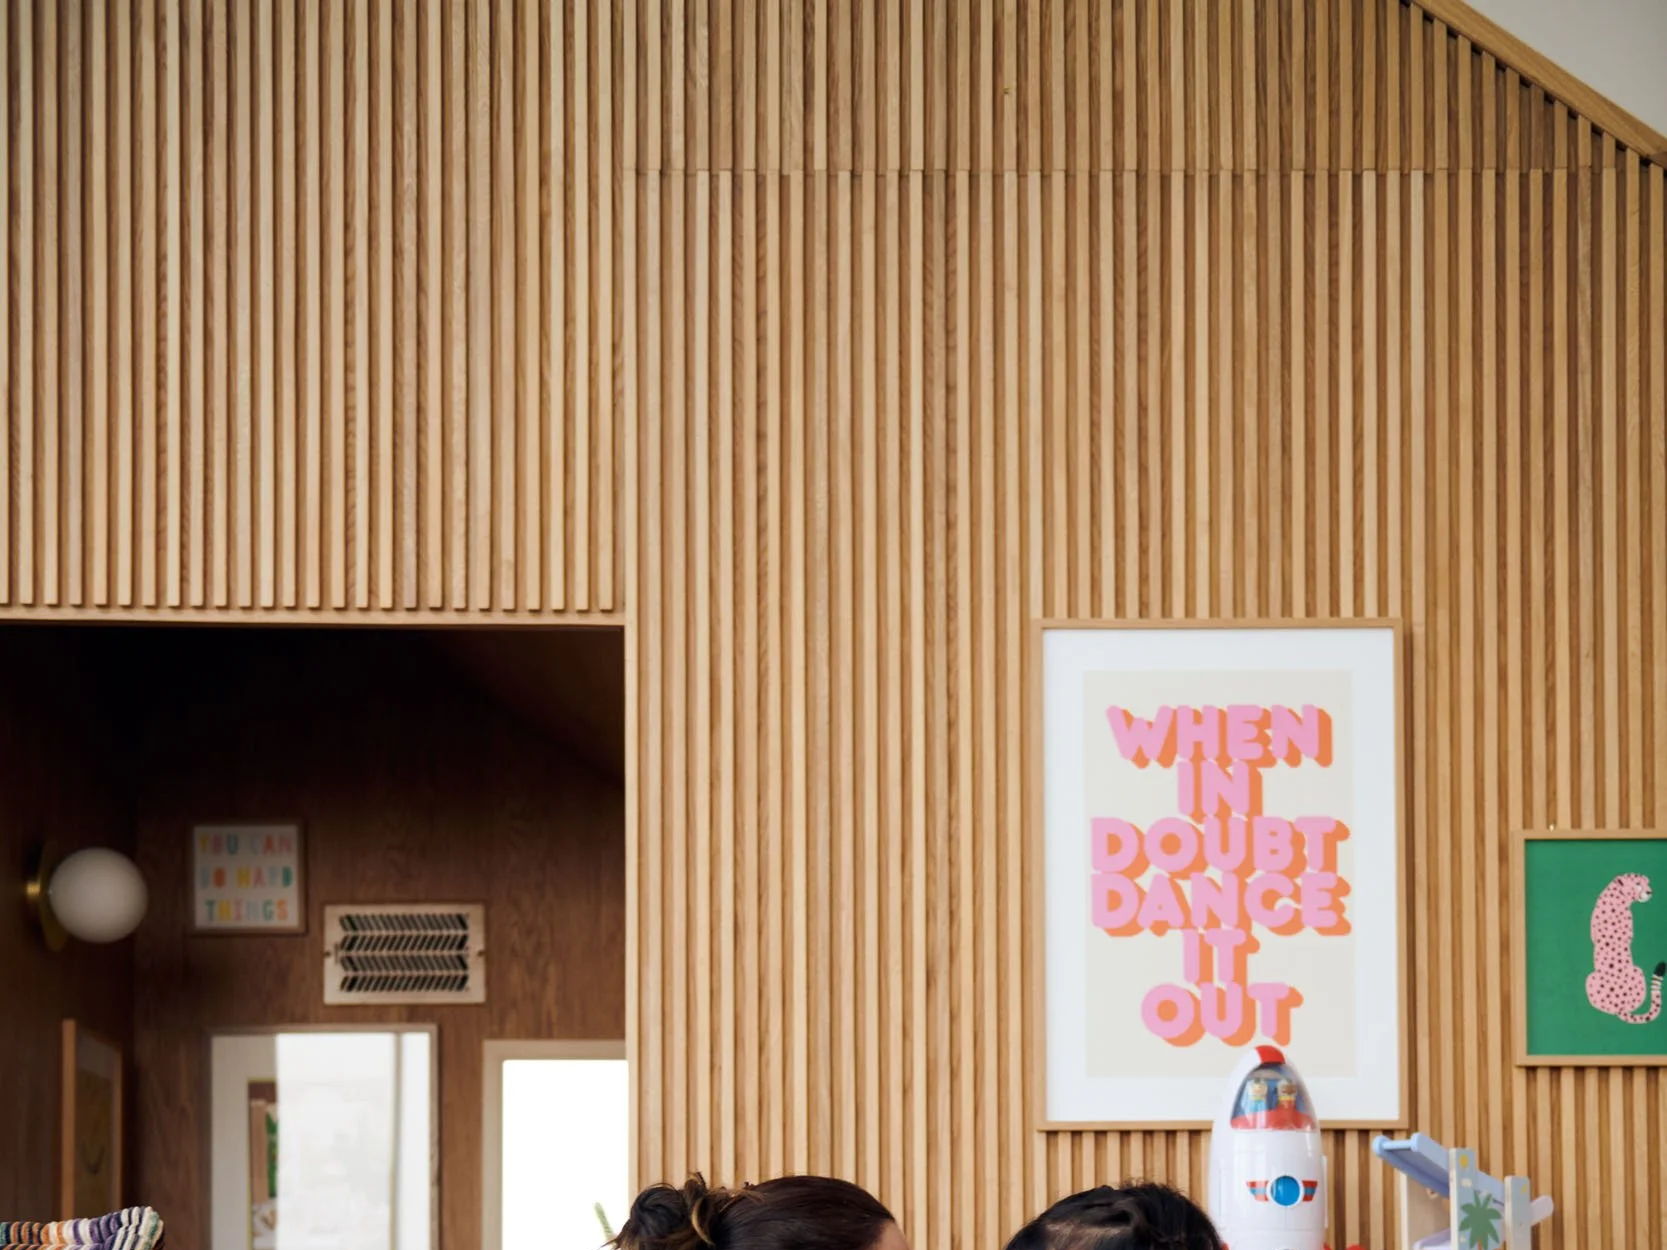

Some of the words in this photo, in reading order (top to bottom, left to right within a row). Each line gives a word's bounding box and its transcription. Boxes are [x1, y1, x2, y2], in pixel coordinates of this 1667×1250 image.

[1106, 705, 1332, 768] WHEN
[1177, 760, 1263, 822] IN
[199, 833, 238, 855] YOU
[250, 834, 293, 855] CAN
[1091, 816, 1350, 879] DOUBT
[200, 866, 226, 888] DO
[1091, 872, 1351, 936] DANCE
[204, 898, 289, 921] THINGS
[1182, 928, 1260, 985] IT
[1141, 982, 1303, 1047] OUT
